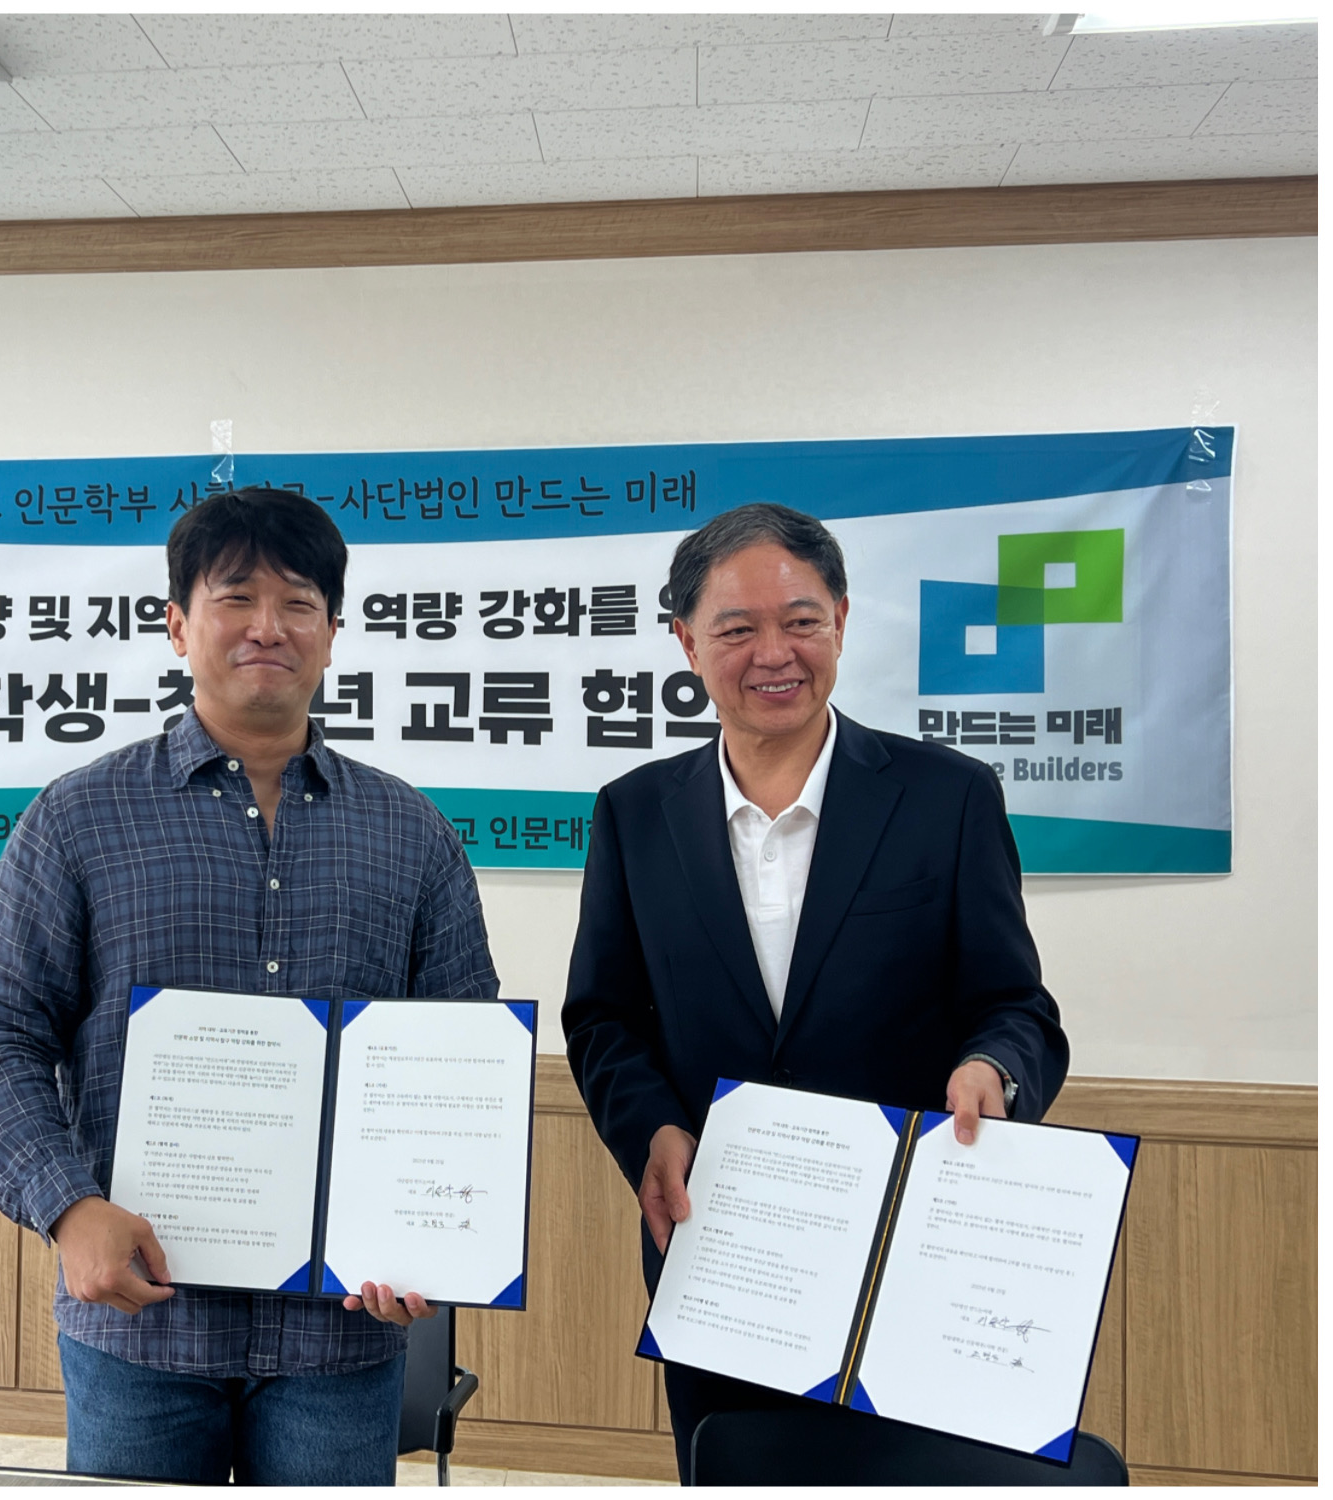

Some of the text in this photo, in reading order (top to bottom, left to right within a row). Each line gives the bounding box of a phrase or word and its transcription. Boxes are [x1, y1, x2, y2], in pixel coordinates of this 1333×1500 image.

[14, 483, 157, 525] 인문학부
[169, 475, 479, 520] 사-사단법인
[496, 474, 611, 518] 만드는
[625, 469, 697, 514] 미래
[28, 595, 72, 641] 및
[86, 595, 170, 641] 지역
[362, 591, 463, 640] 역량
[479, 584, 639, 640] 강화를
[401, 671, 553, 745] 교류
[581, 668, 721, 749] 협약
[918, 707, 1122, 745] 만드는 미래
[1013, 756, 1123, 781] Builders
[489, 815, 593, 851] 인문대
